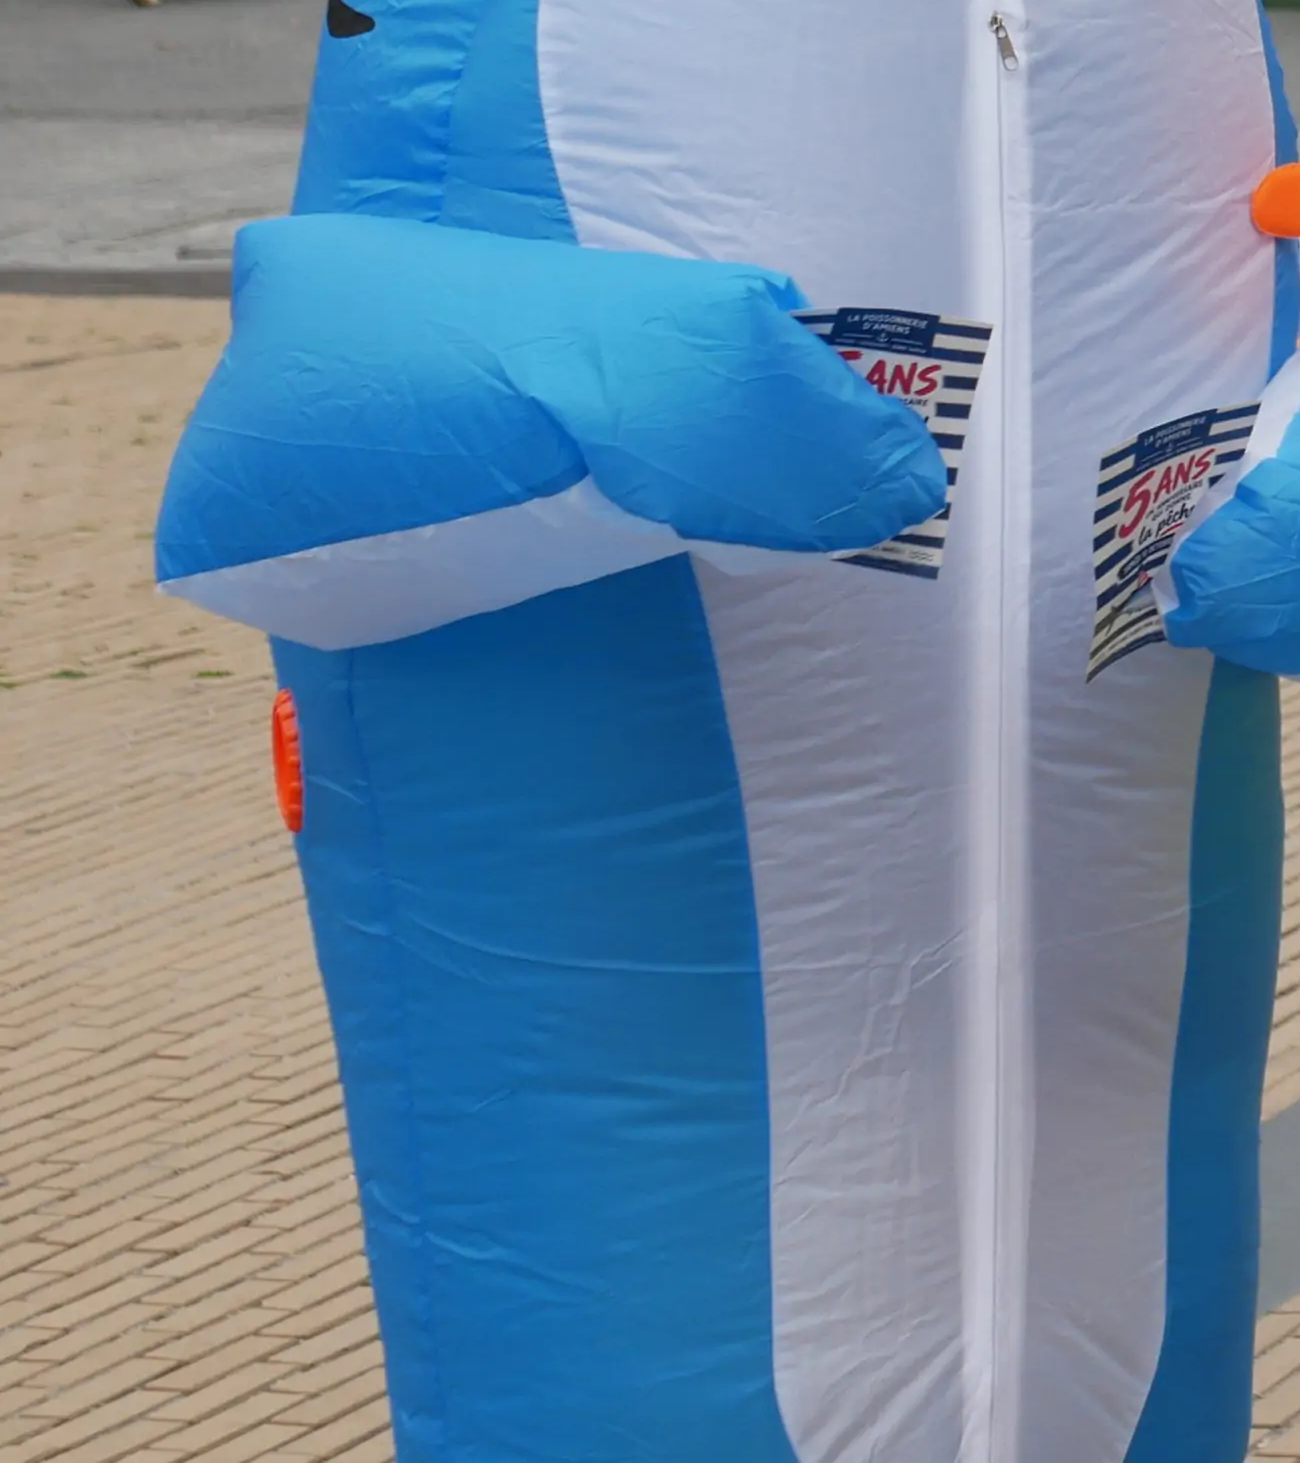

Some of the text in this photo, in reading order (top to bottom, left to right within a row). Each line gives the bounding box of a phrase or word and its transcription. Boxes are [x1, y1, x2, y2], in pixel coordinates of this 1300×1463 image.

[846, 313, 929, 329] LA POISSONNERIE
[862, 322, 911, 335] D'AMIENS
[865, 359, 942, 396] ANS
[1118, 469, 1156, 539] 5
[1153, 448, 1216, 504] ANS
